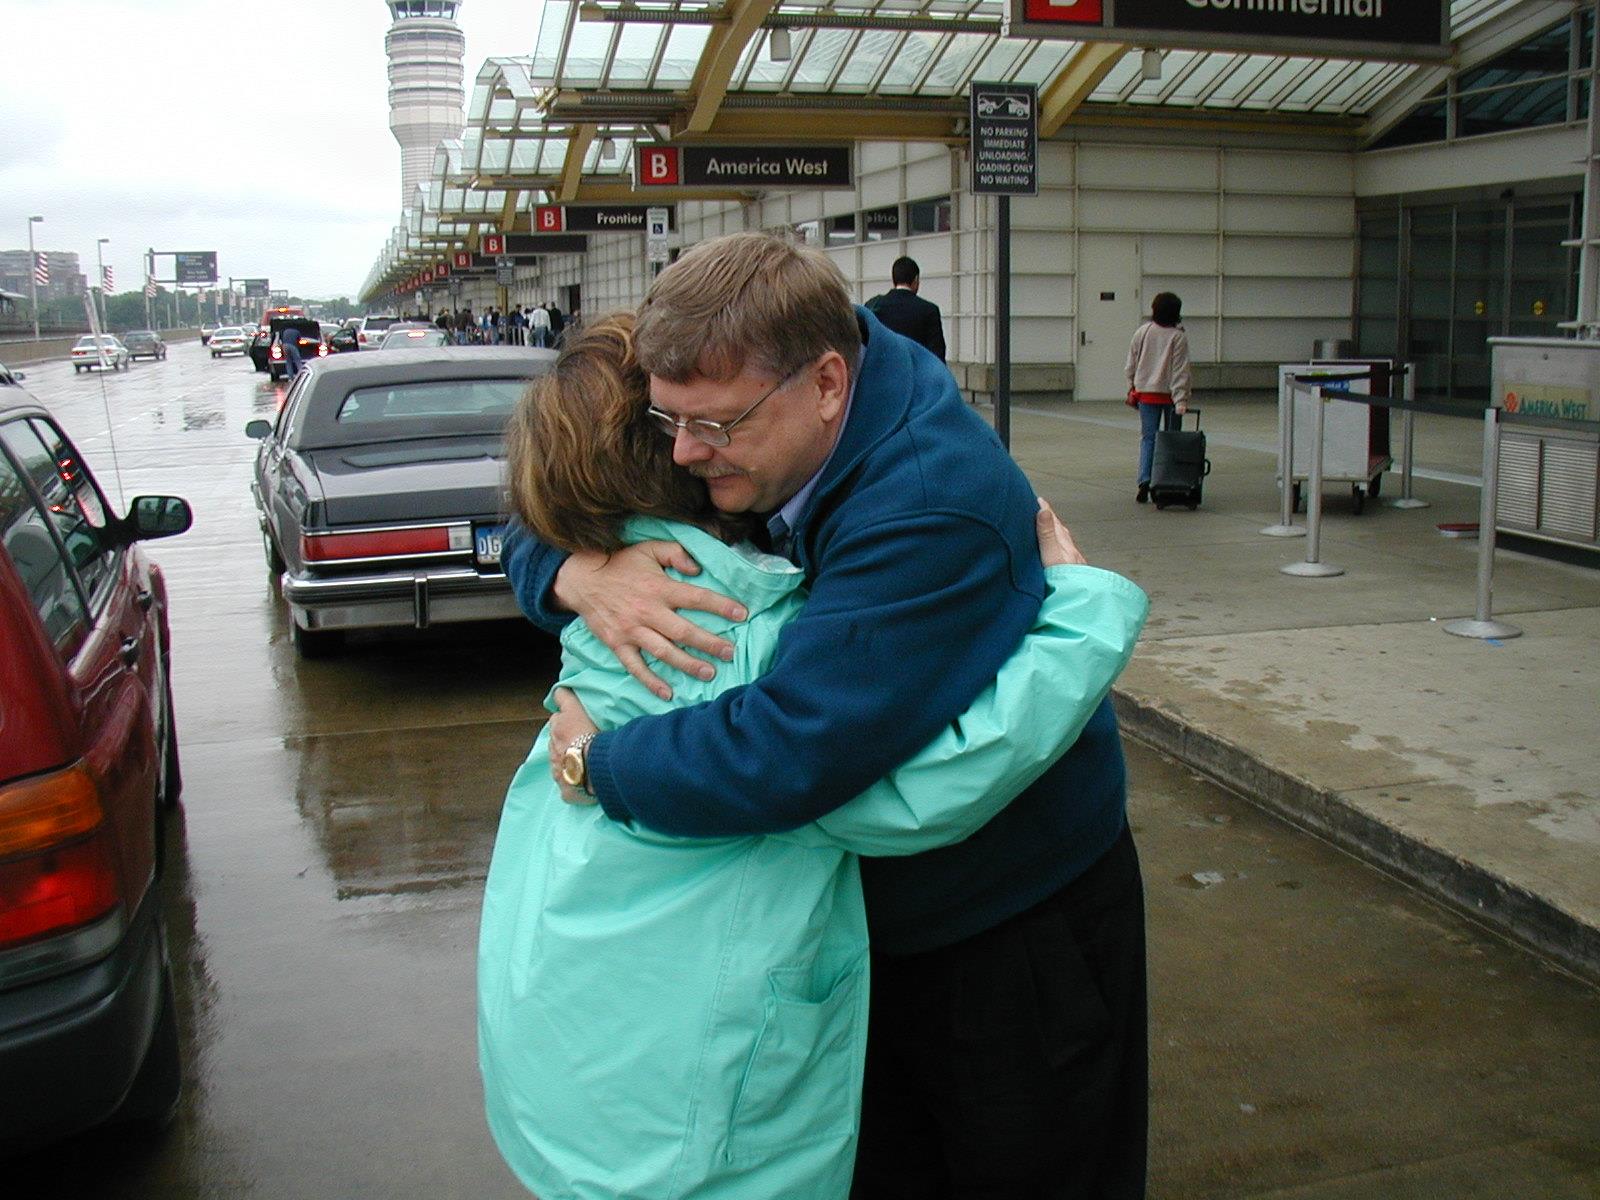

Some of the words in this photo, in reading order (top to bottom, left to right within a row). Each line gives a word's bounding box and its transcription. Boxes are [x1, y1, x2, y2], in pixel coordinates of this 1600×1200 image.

[1185, 0, 1383, 18] nental
[980, 126, 994, 136] NO
[995, 127, 1029, 137] PARKING
[983, 139, 1026, 149] IMMEDIATE
[651, 154, 668, 178] B
[706, 157, 781, 175] America
[785, 157, 829, 175] West
[976, 163, 1012, 173] LOADING
[1013, 163, 1034, 173] ONLY
[980, 175, 994, 185] NO
[995, 175, 1029, 186] WAITING
[543, 211, 555, 227] B
[597, 212, 644, 225] Frontier
[489, 239, 498, 251] B
[458, 253, 467, 265] B
